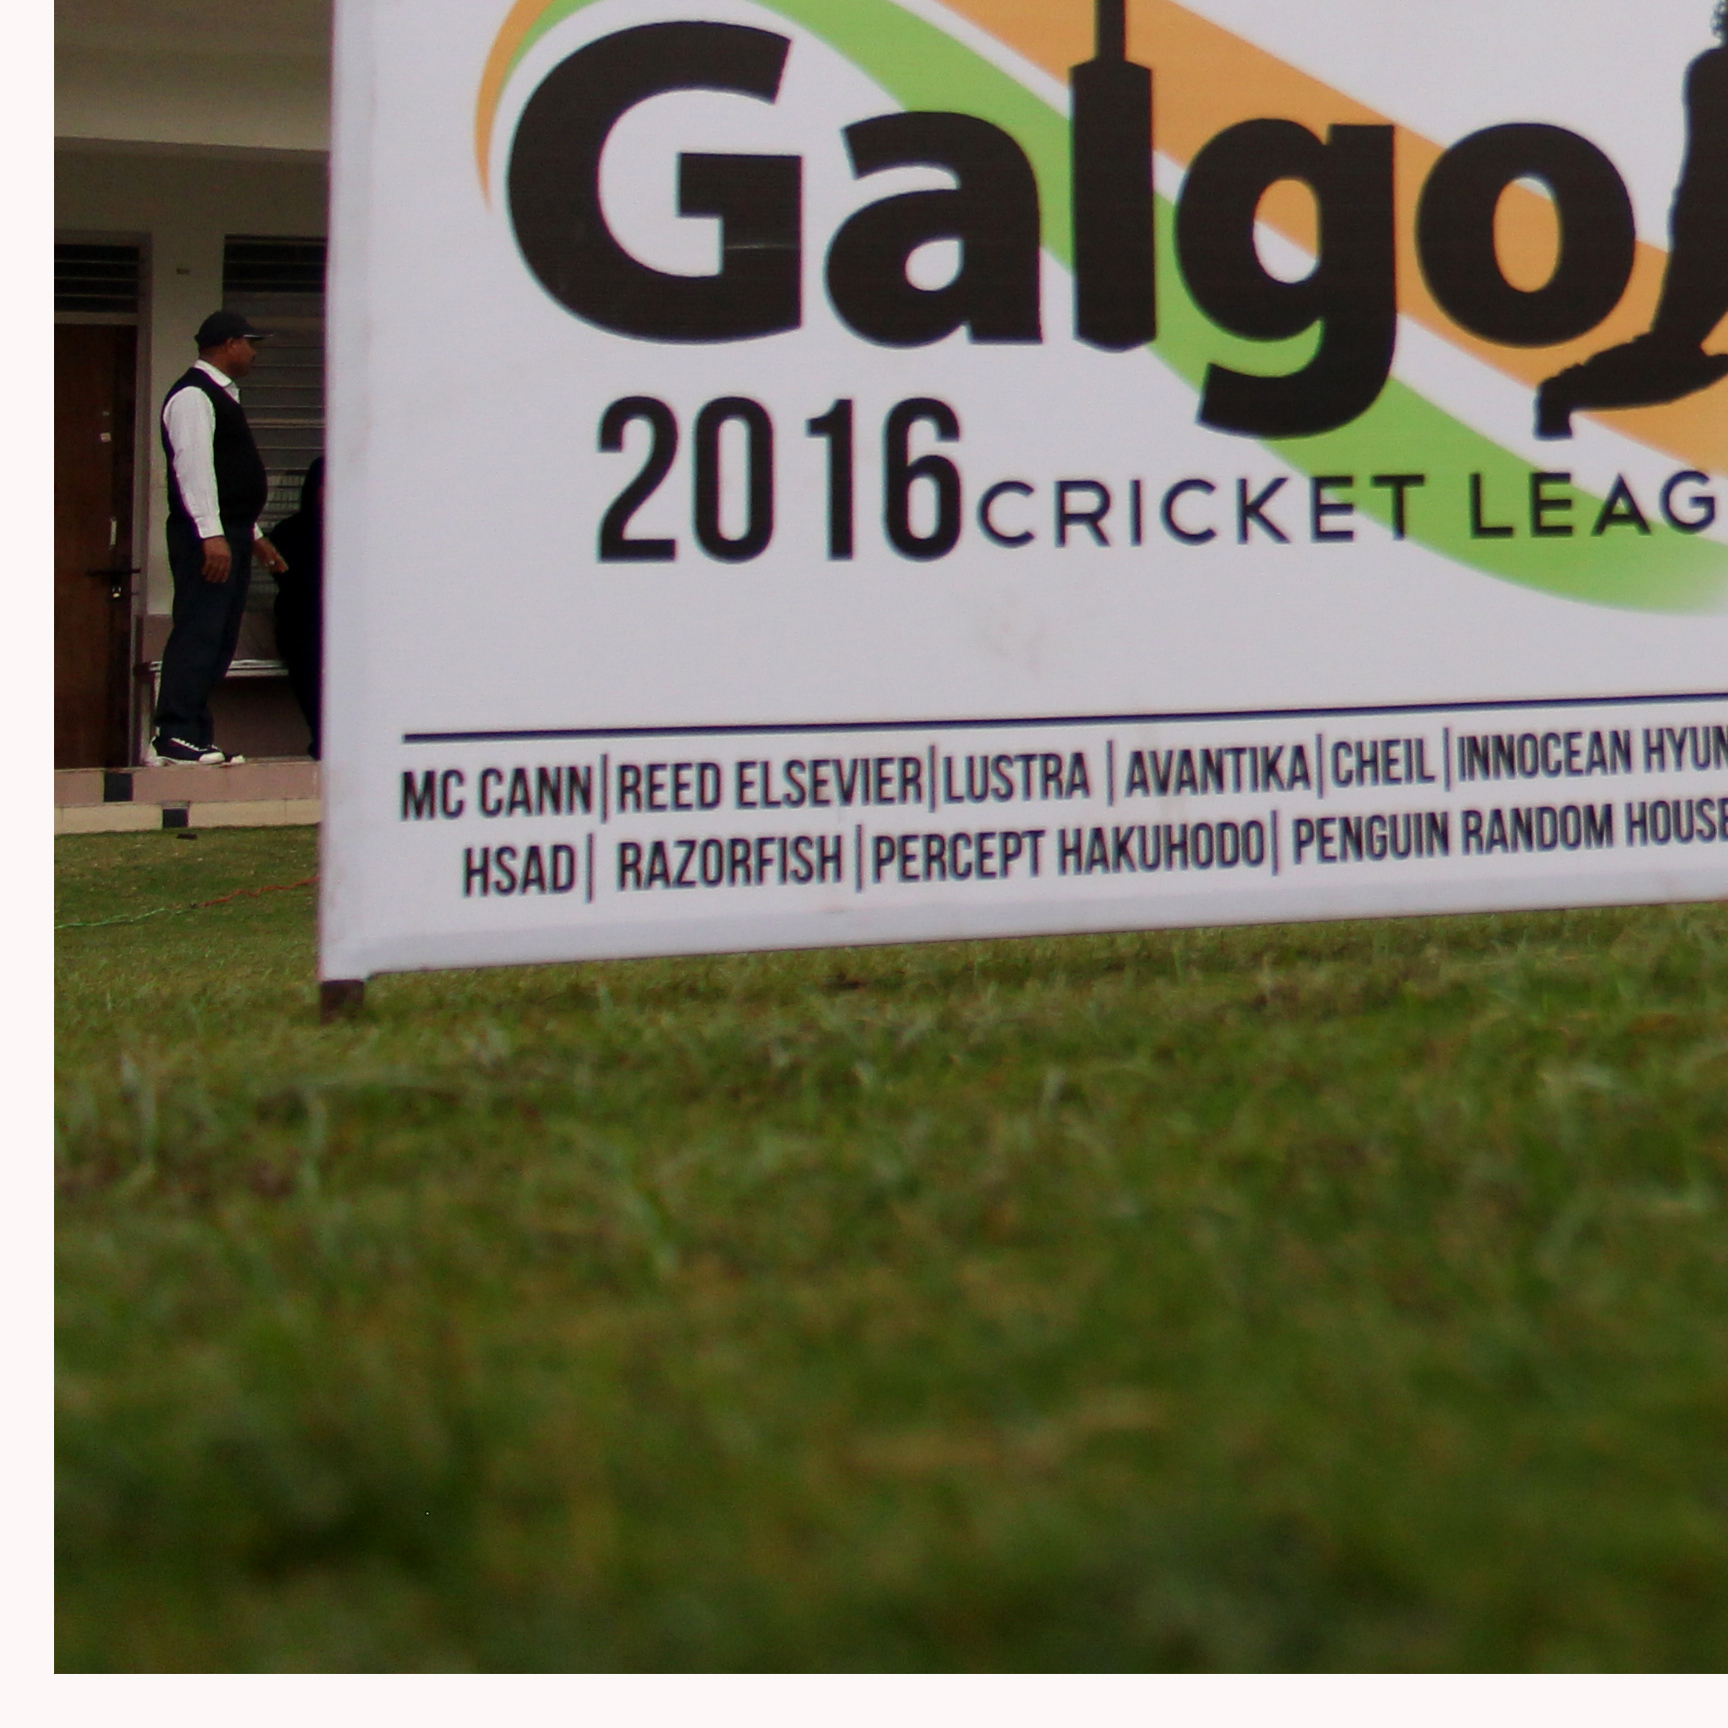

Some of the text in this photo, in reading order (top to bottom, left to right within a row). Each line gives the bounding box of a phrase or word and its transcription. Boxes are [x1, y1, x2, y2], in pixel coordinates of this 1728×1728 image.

[598, 396, 962, 563] 2016
[977, 475, 1427, 549] CRICKET
[400, 770, 465, 821] MC
[477, 764, 593, 819] CANN
[618, 761, 722, 812] REED
[735, 755, 922, 808] ELSEVIER
[943, 751, 1090, 805] LUSTRA
[1124, 743, 1312, 800] AVANTIKA
[1331, 738, 1435, 790] CHEIL
[1457, 729, 1631, 783] INNOCEAN
[462, 843, 576, 898] HSAD
[616, 834, 843, 892] RAZORFISH
[871, 829, 1045, 884] PERCEPT
[1056, 819, 1265, 879] HAKUHODO
[1293, 808, 1451, 866] PENGUIN
[1460, 801, 1614, 859] RANDOM
